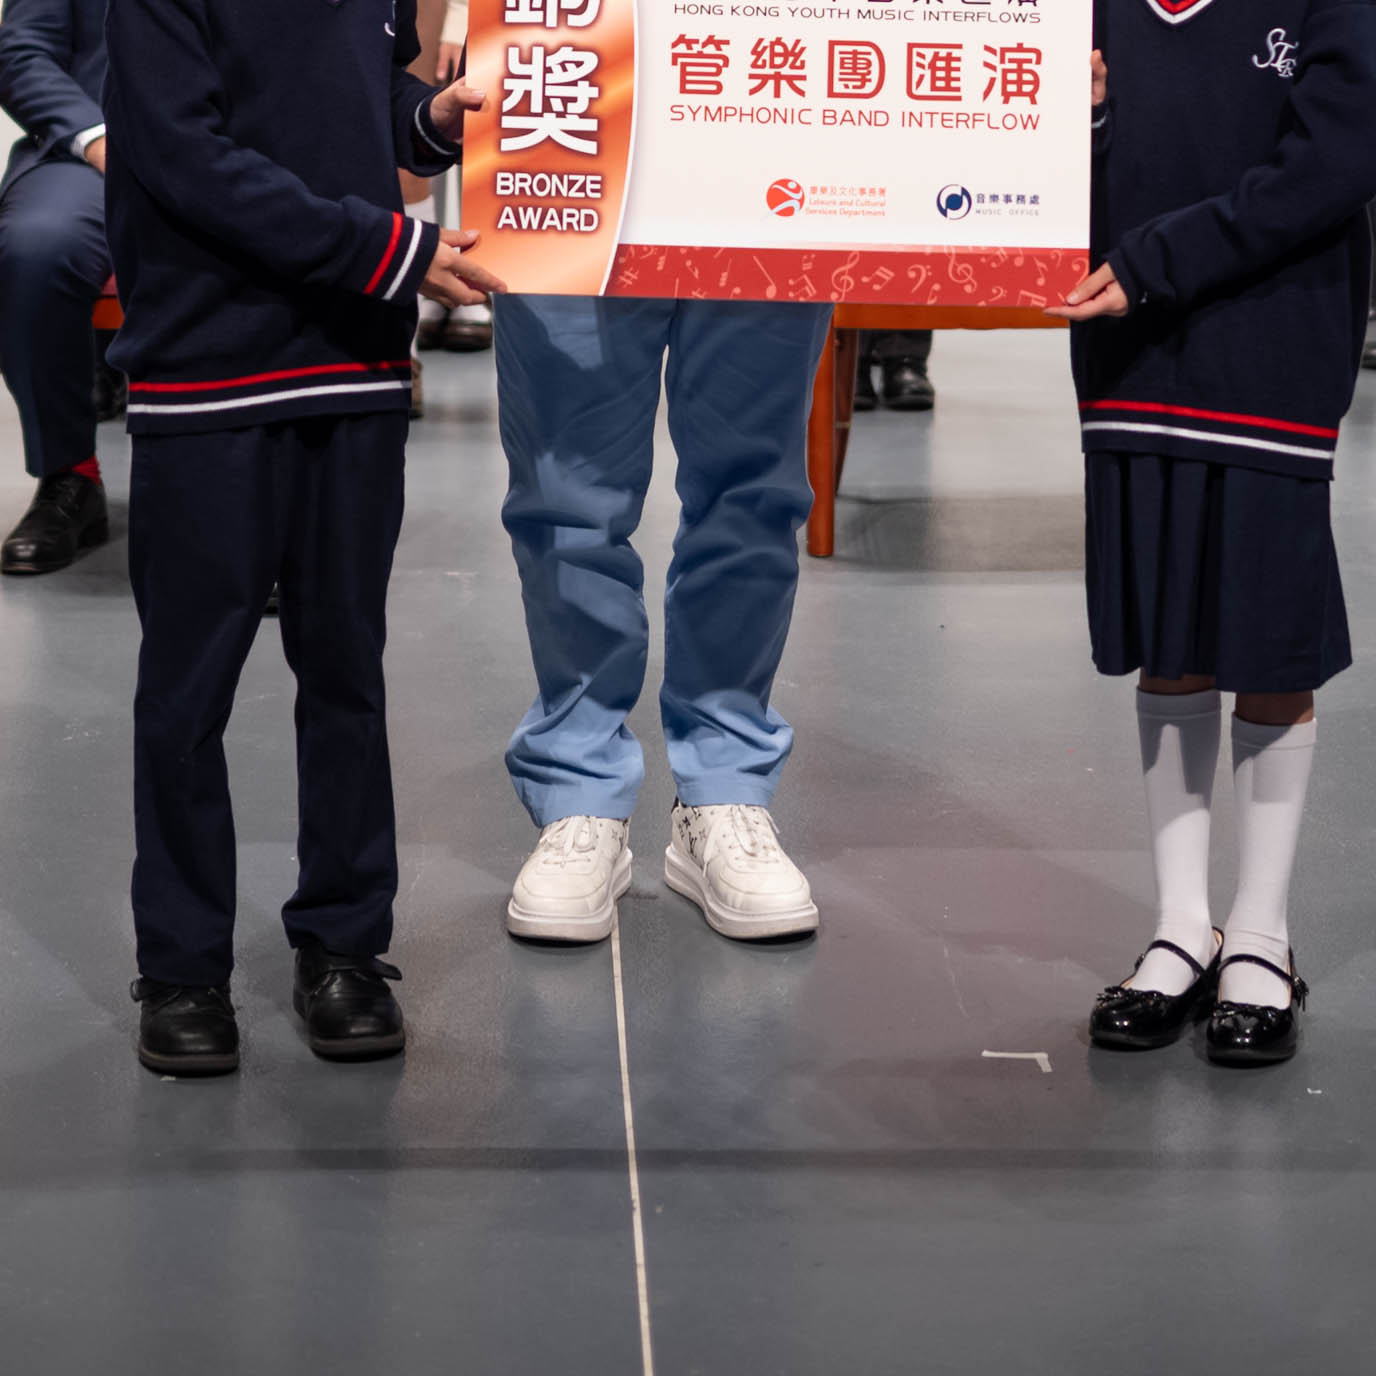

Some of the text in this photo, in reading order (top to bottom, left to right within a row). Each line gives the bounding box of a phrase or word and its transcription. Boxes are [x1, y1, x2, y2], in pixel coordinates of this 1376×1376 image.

[674, 3, 1041, 24] HONG KONG YOUTH MUSIC INTERFLOWS
[671, 33, 1042, 105] 管樂團匯演
[670, 104, 1040, 131] SYMPHONIC BAND INTERFLOW
[496, 171, 602, 198] BRONZE
[497, 206, 599, 232] AWARD
